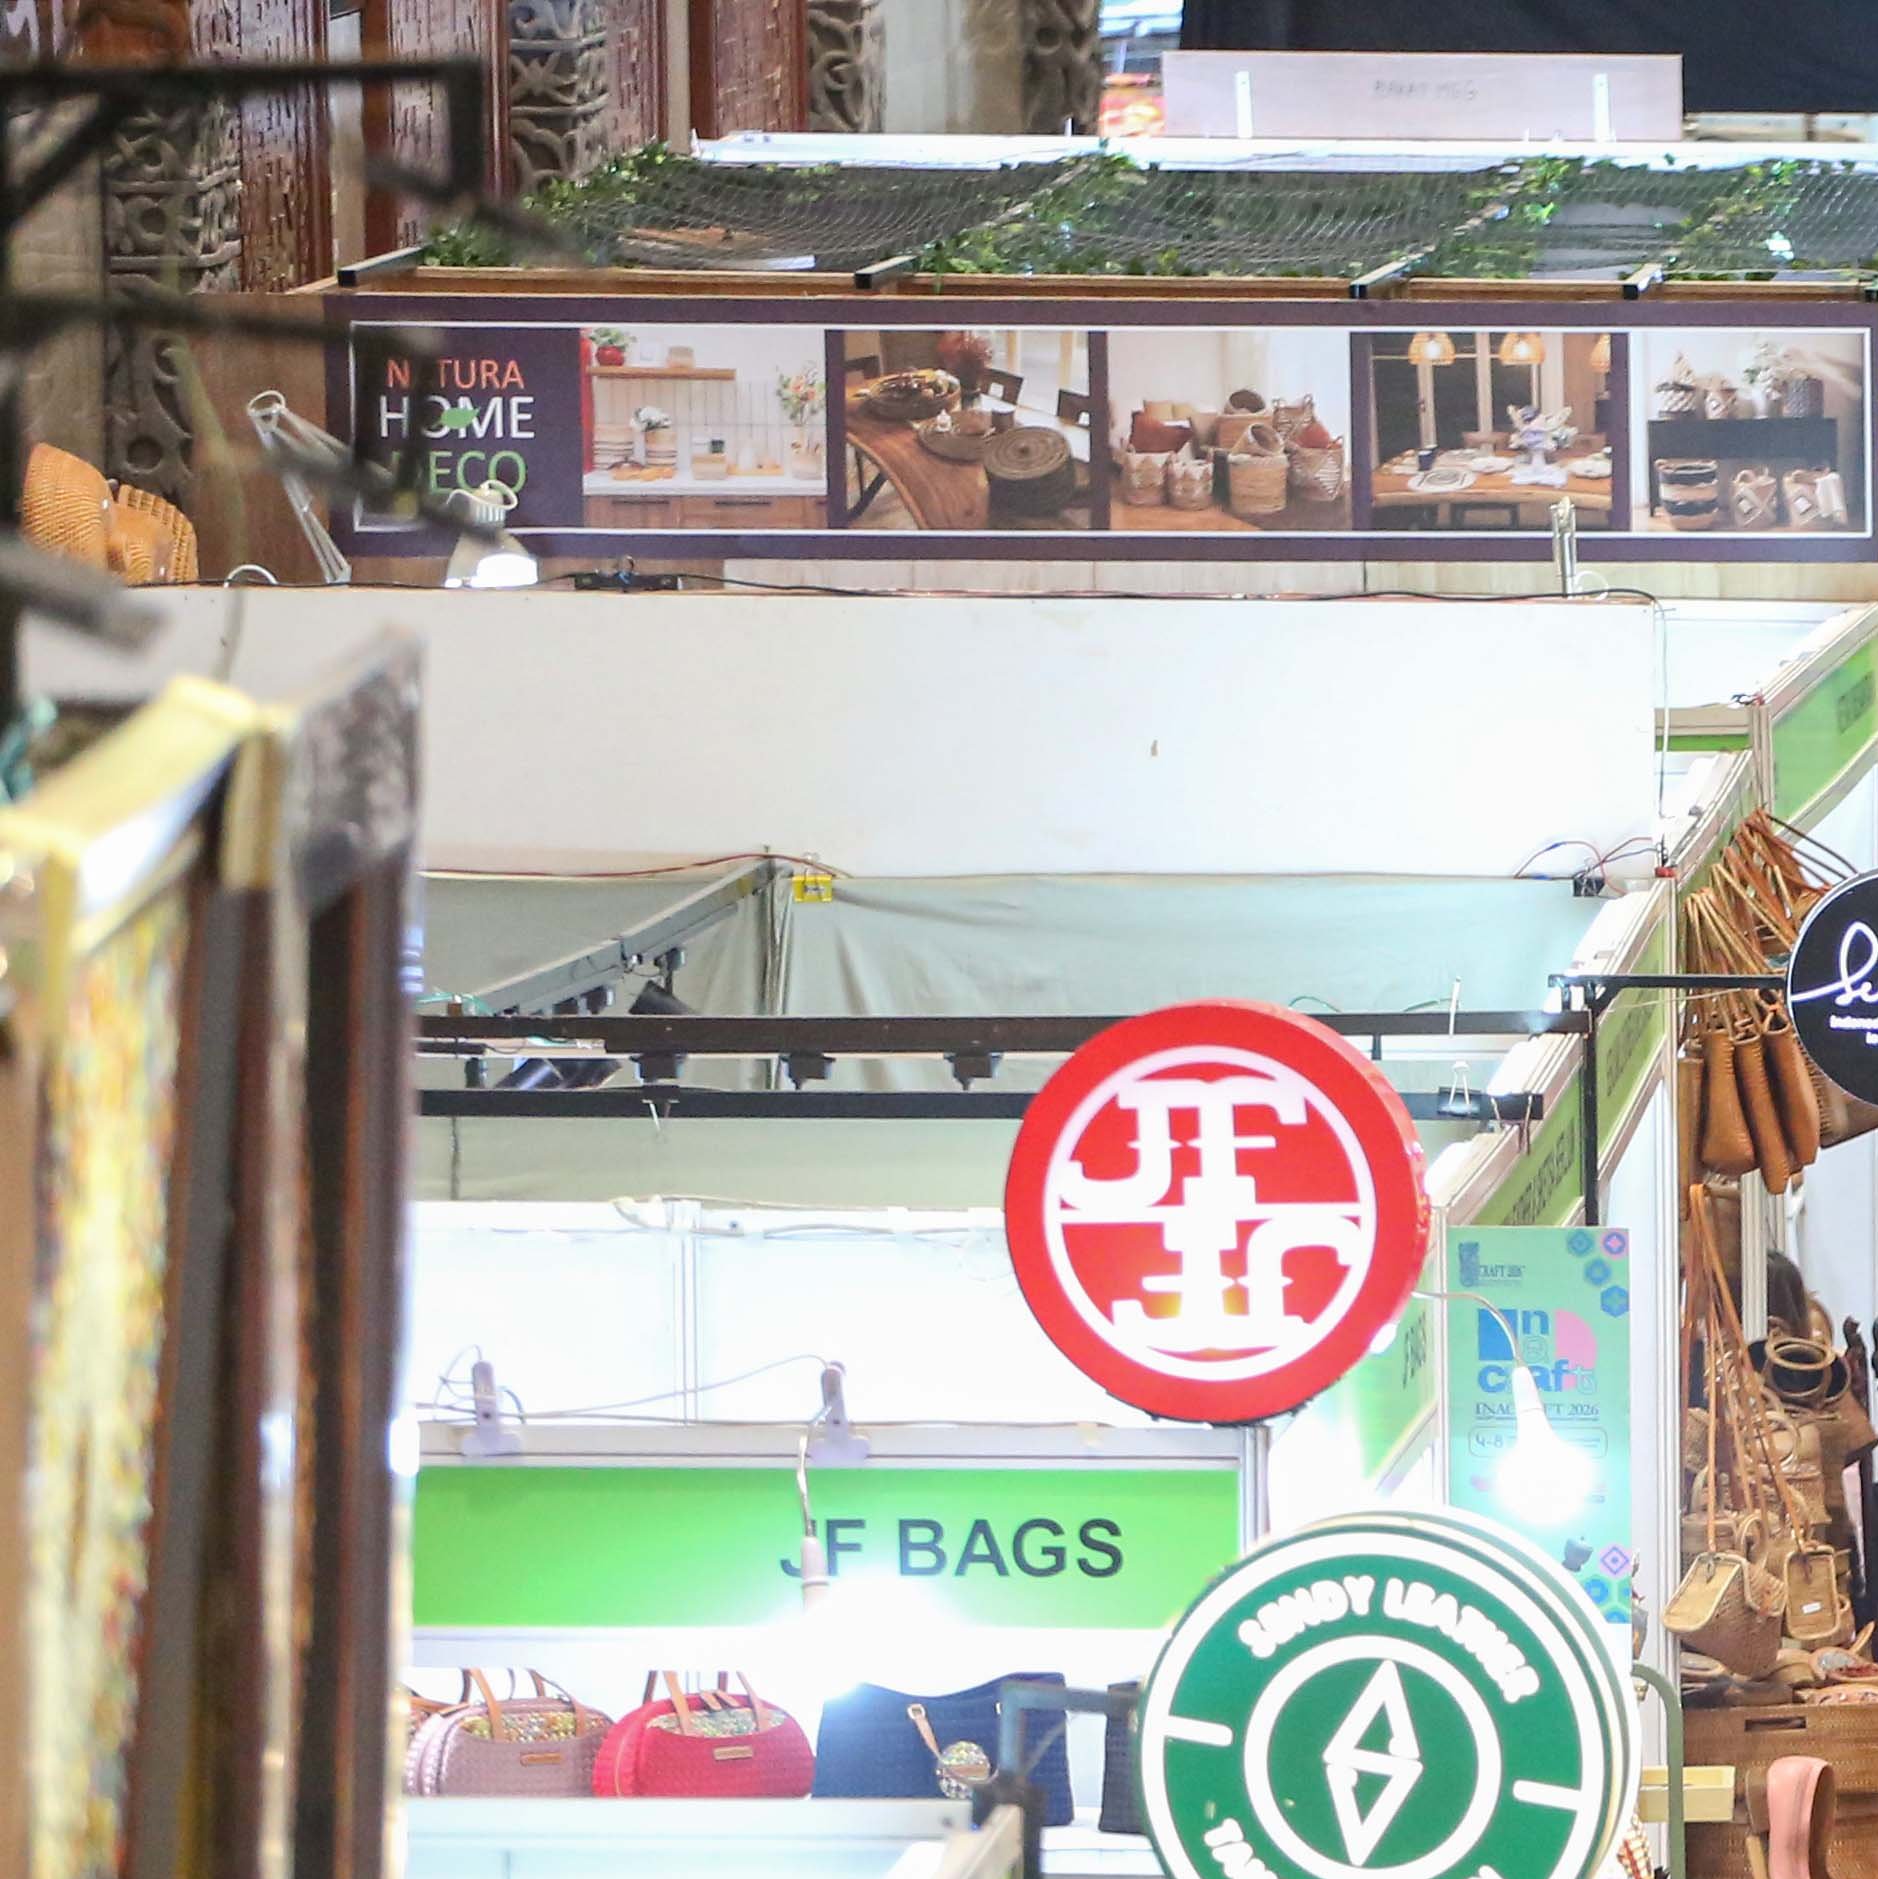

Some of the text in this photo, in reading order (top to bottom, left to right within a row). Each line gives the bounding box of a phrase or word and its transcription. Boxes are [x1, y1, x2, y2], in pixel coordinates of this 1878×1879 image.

[387, 359, 525, 389] NTURA
[380, 395, 535, 438] HOME
[392, 450, 526, 496] ECO
[1567, 1403, 1599, 1416] 2026
[898, 1518, 1124, 1578] BAGS
